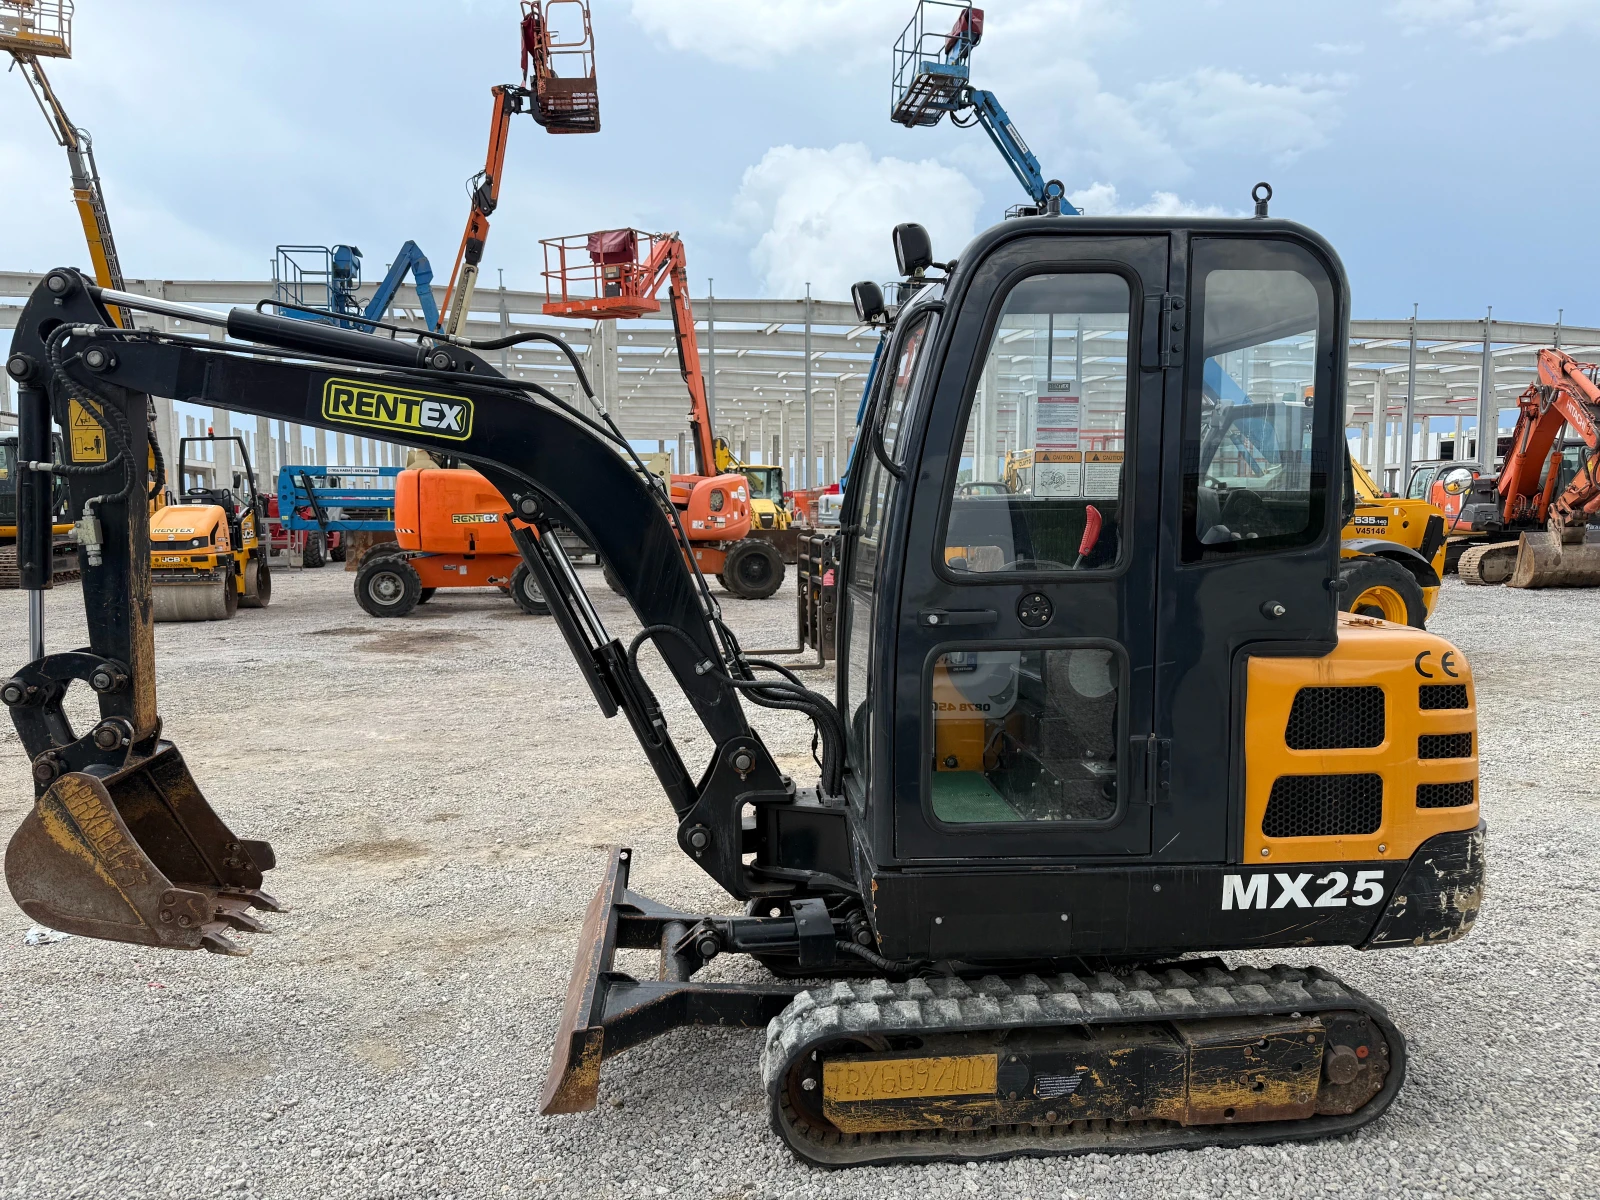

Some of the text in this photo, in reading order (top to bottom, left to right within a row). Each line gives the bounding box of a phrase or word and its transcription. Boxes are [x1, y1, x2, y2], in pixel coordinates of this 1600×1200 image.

[329, 386, 466, 433] RENTEX
[1566, 399, 1587, 432] HITACHI
[453, 514, 498, 523] RENTEX
[242, 529, 255, 539] JCB
[1355, 527, 1386, 535] V45146
[1221, 870, 1385, 911] MX25
